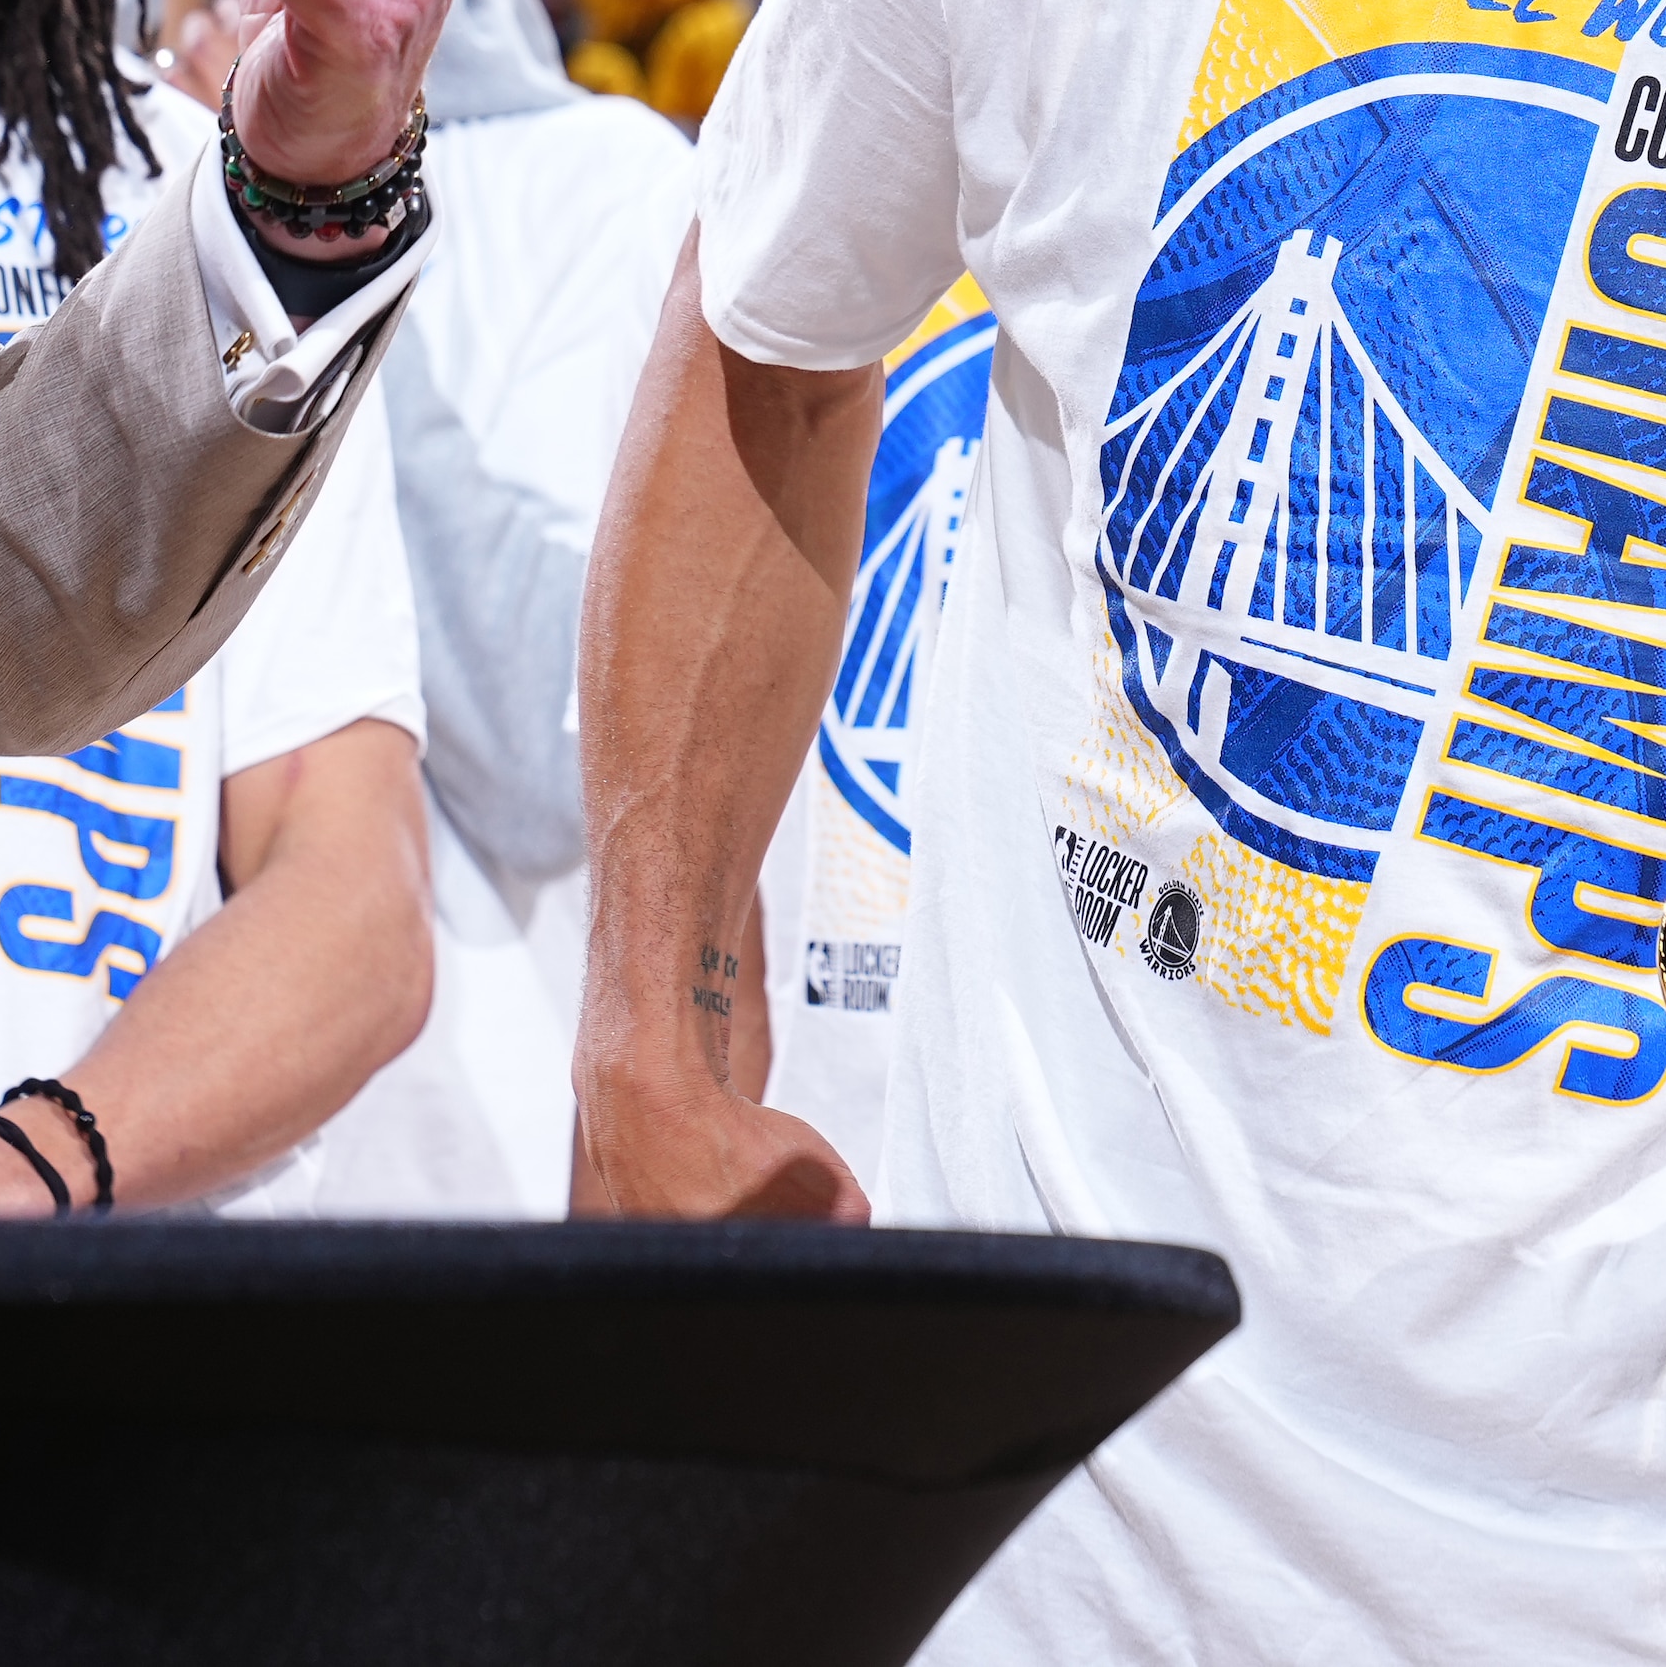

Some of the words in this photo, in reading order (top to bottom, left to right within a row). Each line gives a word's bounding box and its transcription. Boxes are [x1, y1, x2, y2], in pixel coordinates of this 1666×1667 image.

[1079, 839, 1149, 910] LOCKER
[1157, 879, 1186, 896] GOLDEN
[1188, 887, 1205, 917] STATE
[1139, 938, 1197, 982] WARRIORS
